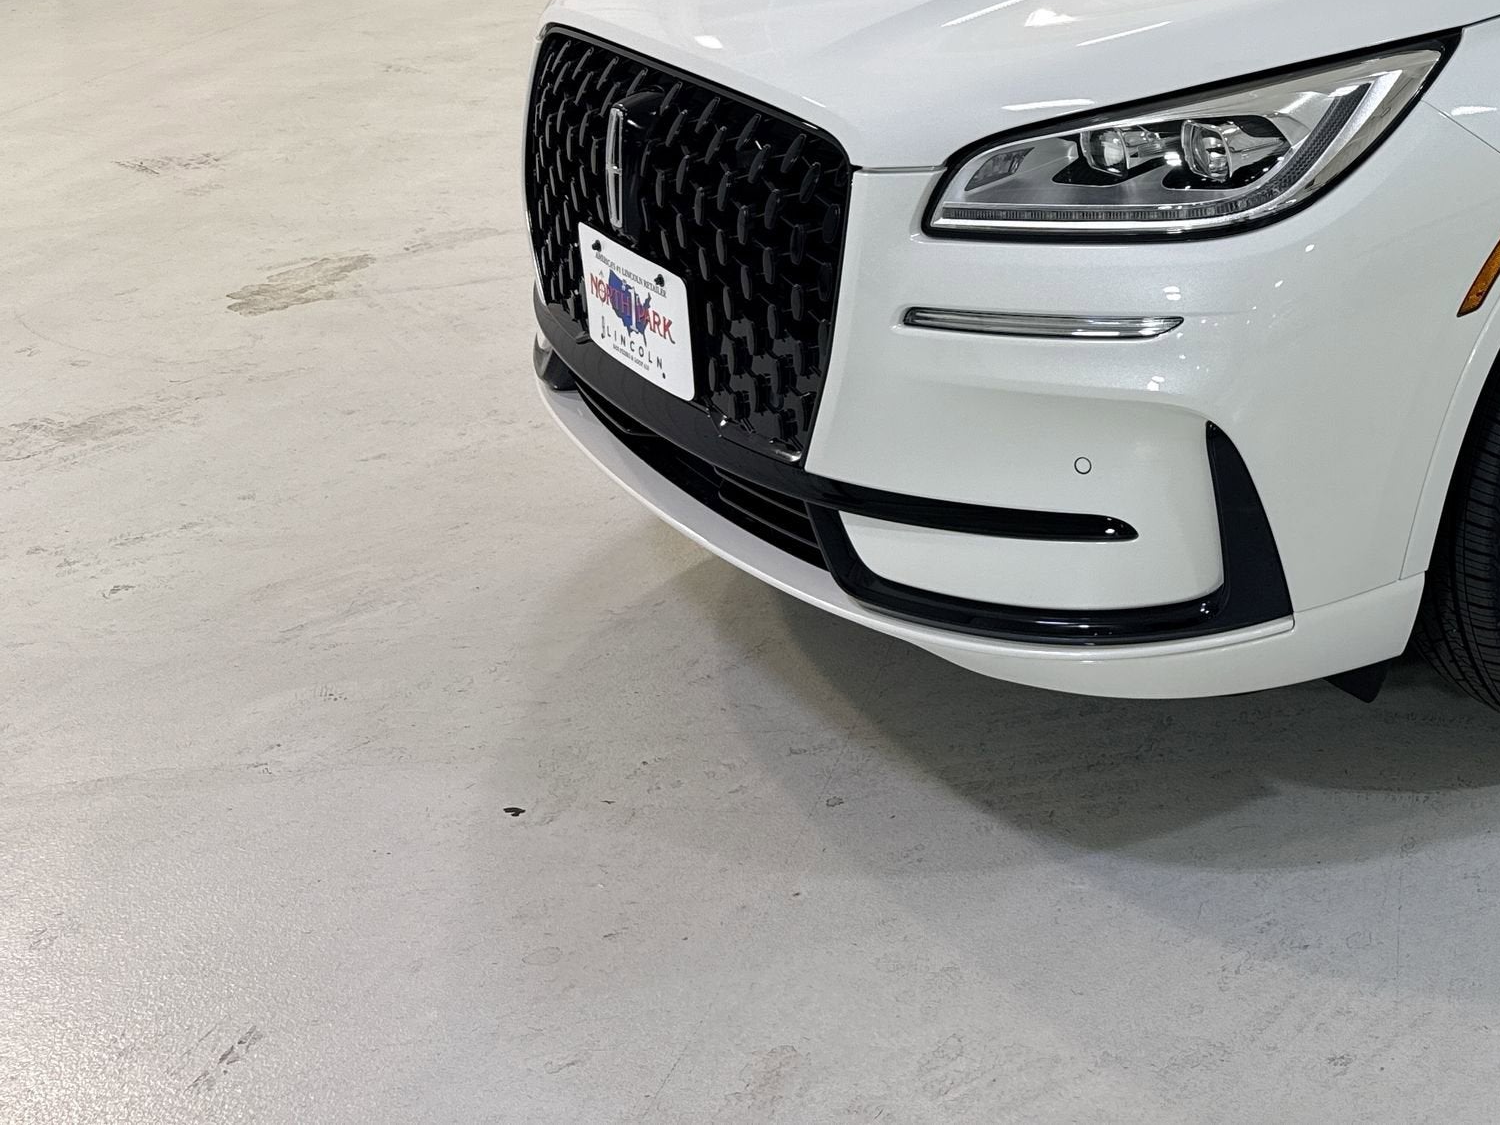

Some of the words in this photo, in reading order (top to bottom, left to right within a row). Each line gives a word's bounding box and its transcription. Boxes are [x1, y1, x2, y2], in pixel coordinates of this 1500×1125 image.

[590, 273, 632, 317] NORTH
[636, 296, 675, 344] PARK
[606, 325, 663, 369] LINCOLN
